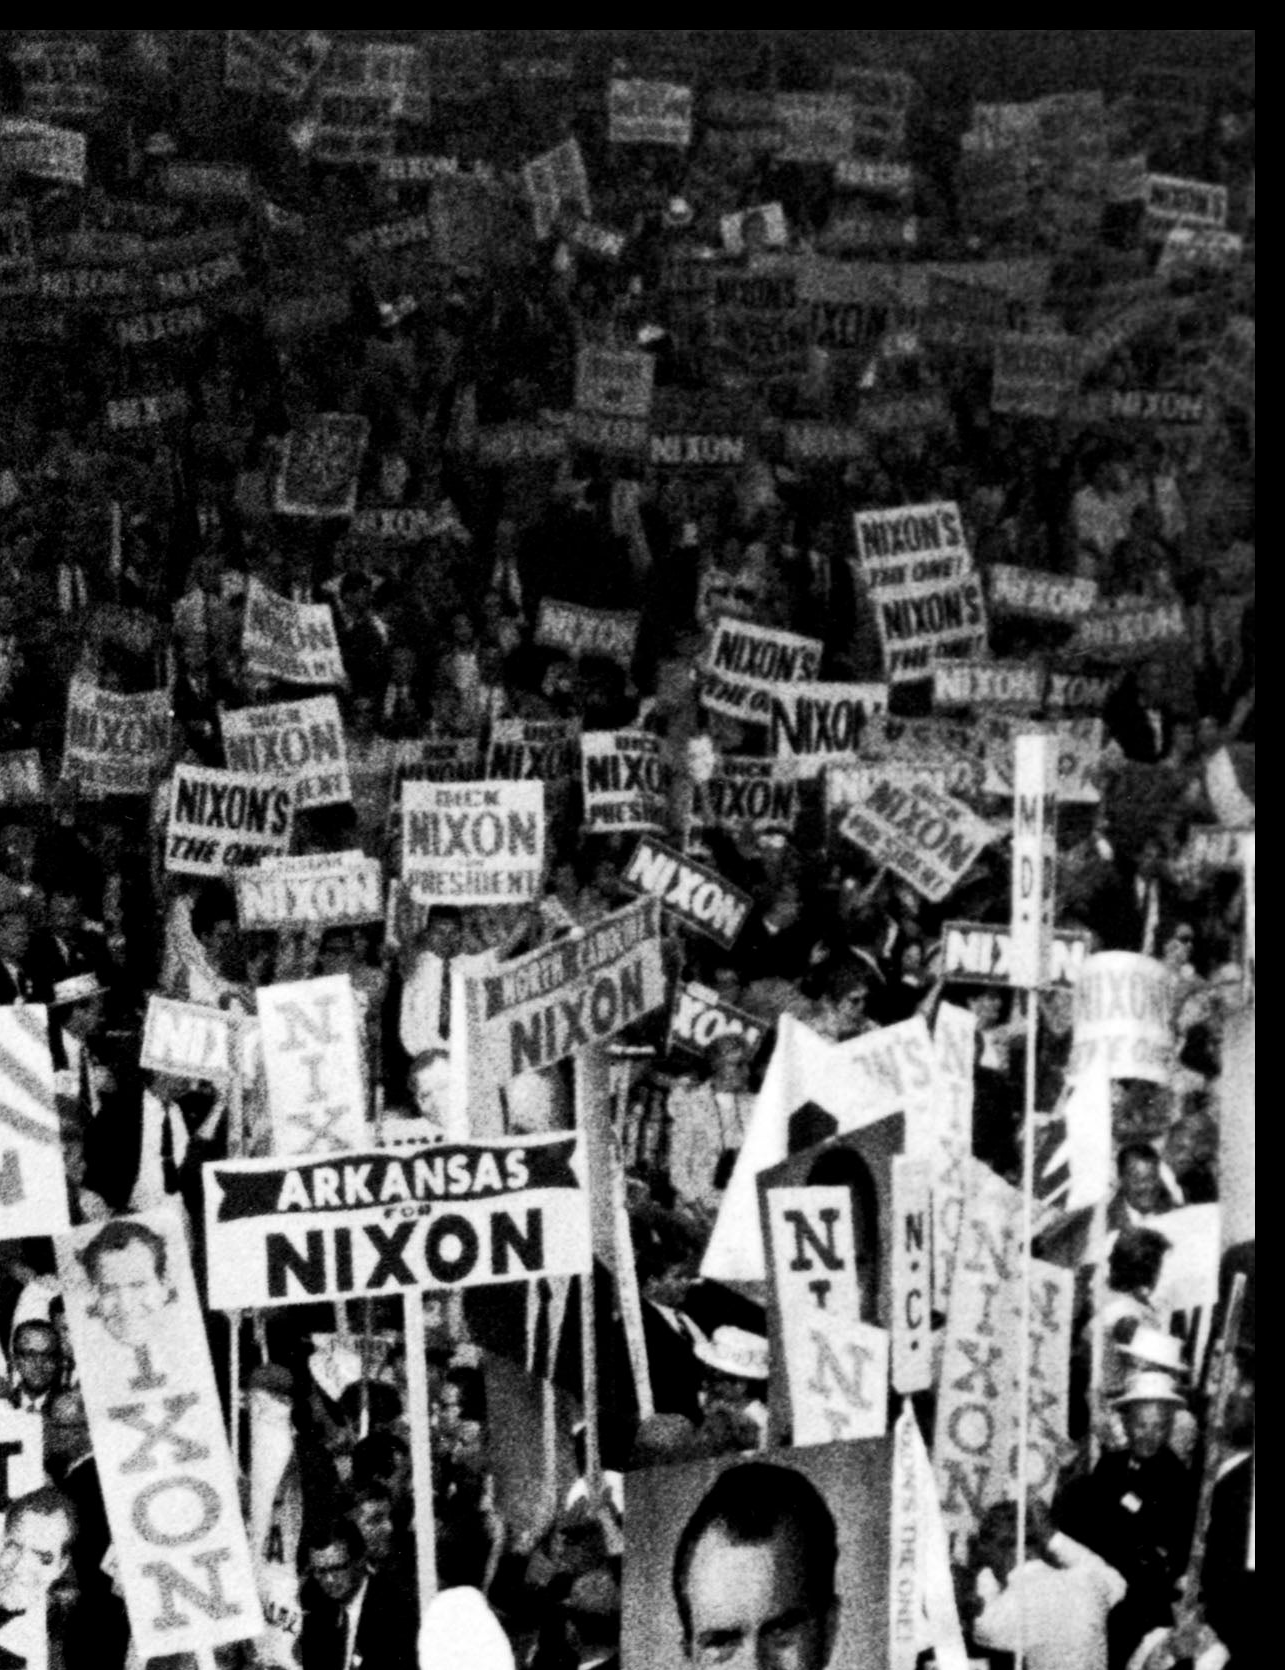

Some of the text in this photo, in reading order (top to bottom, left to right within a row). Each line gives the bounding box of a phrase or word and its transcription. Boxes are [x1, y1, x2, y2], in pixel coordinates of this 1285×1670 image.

[650, 435, 744, 465] NIXON
[586, 754, 669, 794] NIXO
[173, 775, 291, 837] NIXON'S
[406, 811, 538, 857] NIXON
[169, 836, 216, 864] THE
[627, 842, 747, 945] NIXON
[945, 929, 1086, 984] NIN
[277, 1146, 530, 1212] ARKANSAS
[265, 1207, 544, 1299] NIXON
[107, 1343, 244, 1635] IXON
